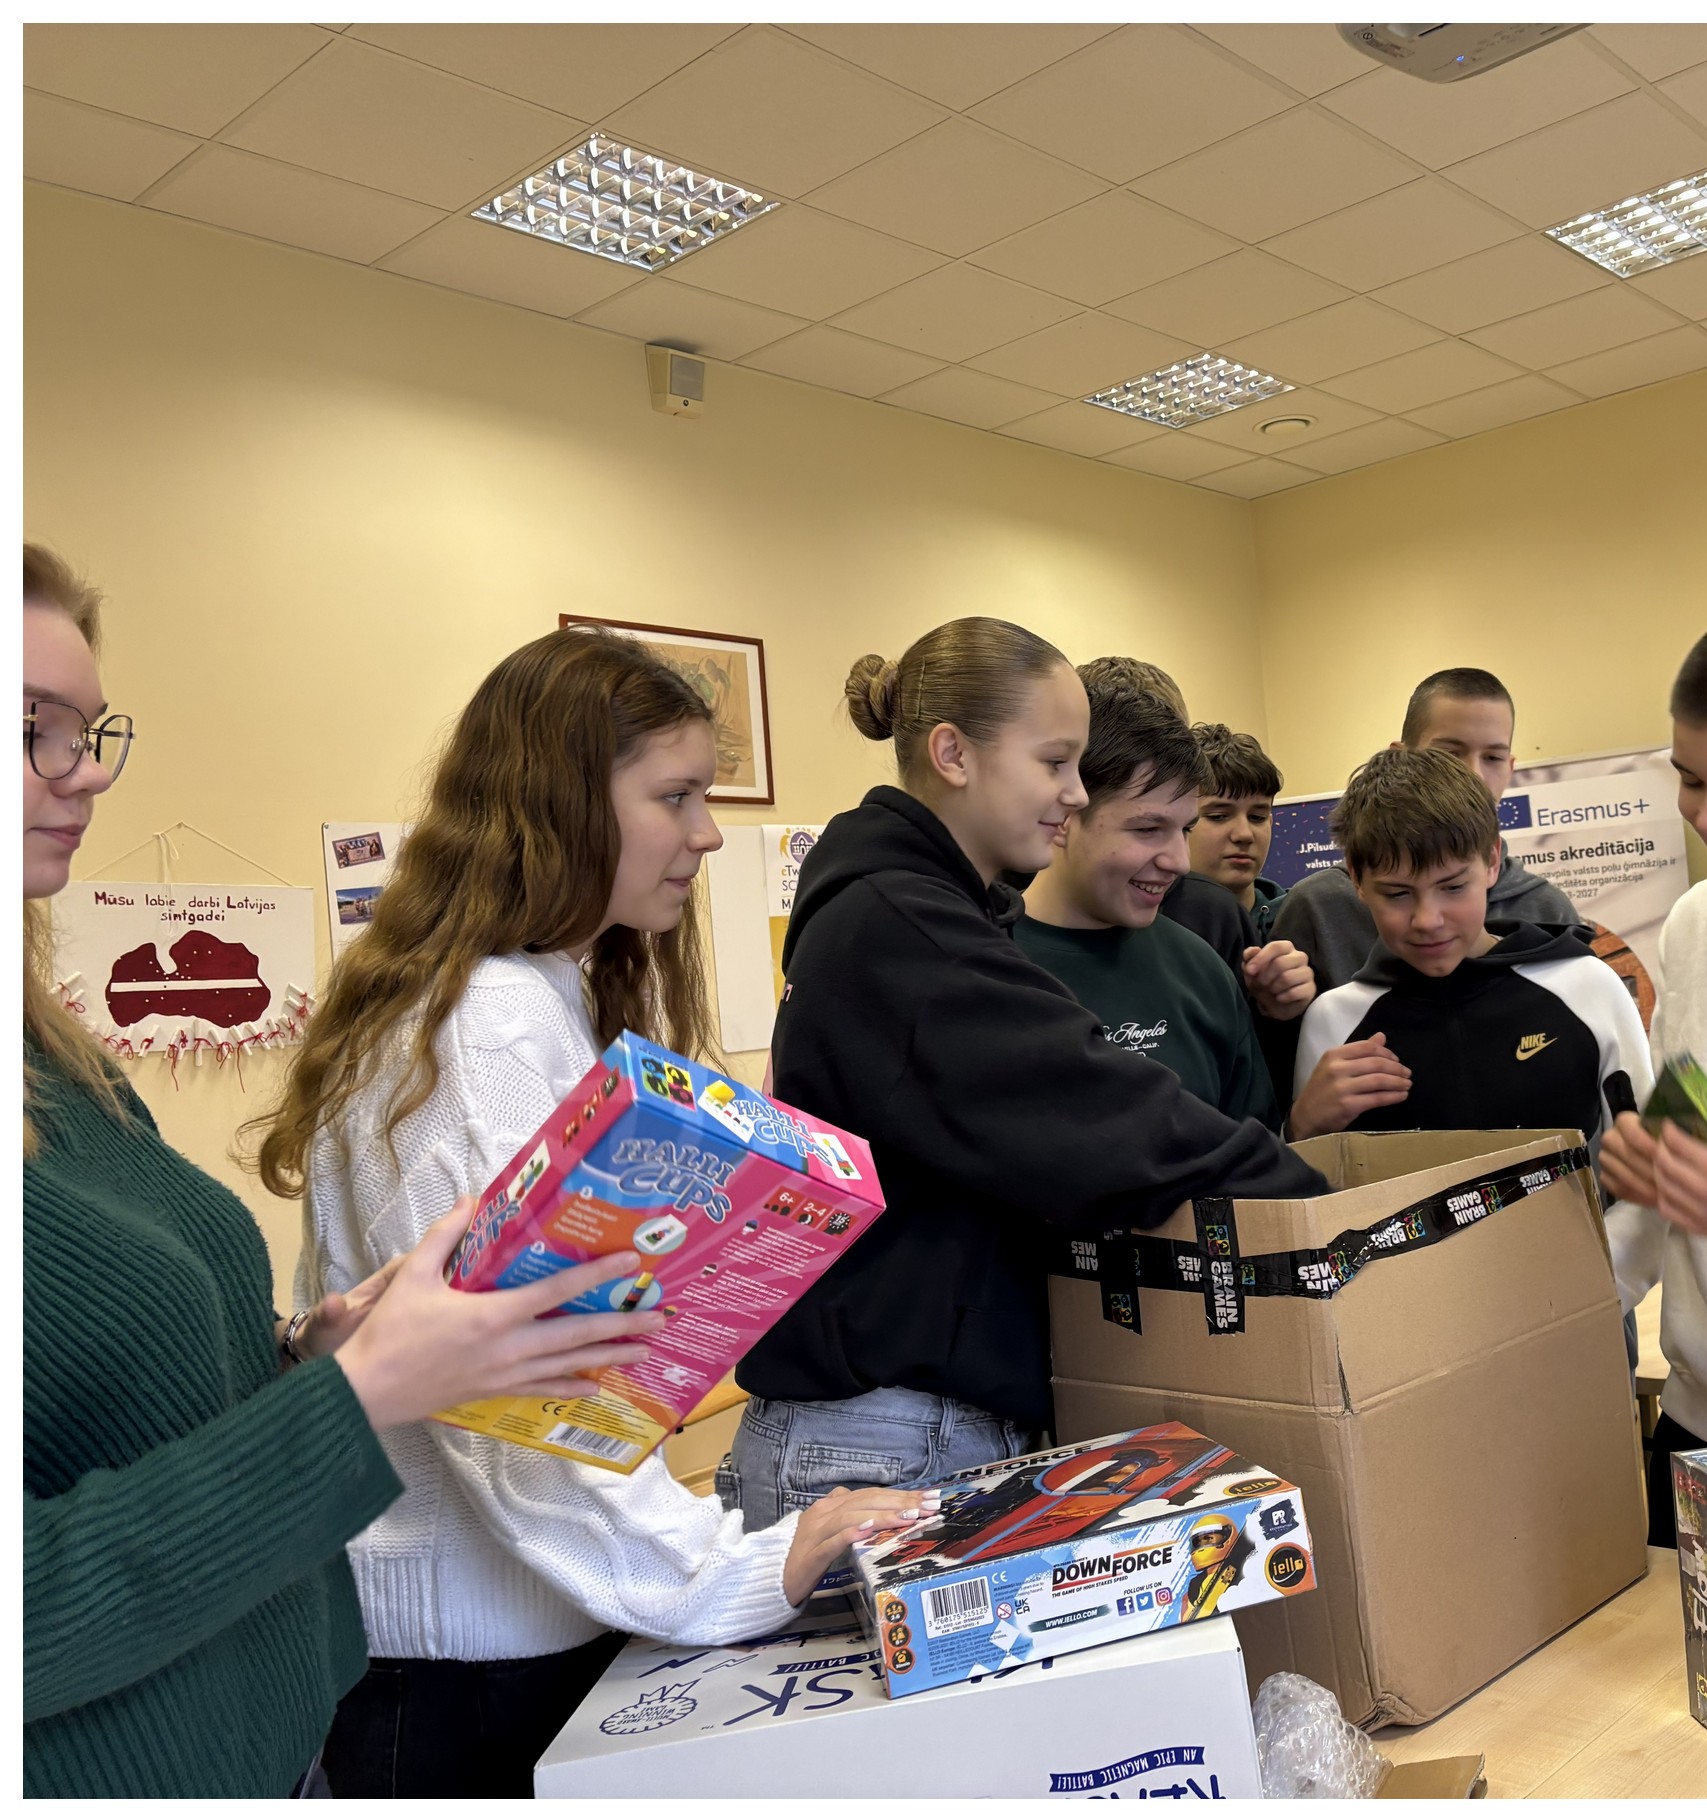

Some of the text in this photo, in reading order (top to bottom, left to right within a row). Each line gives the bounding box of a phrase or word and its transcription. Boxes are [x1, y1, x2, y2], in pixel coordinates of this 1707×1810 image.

[1537, 798, 1650, 827] Erasmus+
[1560, 838, 1655, 861] akreditācija
[1306, 859, 1331, 869] valsts
[1623, 859, 1668, 873] ģimnāzija
[1589, 873, 1644, 887] organizācija
[95, 891, 276, 915] Mūsu labie darbi Latvijas
[161, 910, 225, 925] simtgadei
[1520, 1032, 1547, 1050] NIKE
[734, 1097, 808, 1139] HALLI
[612, 1138, 736, 1186] HALLI
[614, 1163, 732, 1223] Cups
[1447, 1193, 1482, 1214] GAMES
[1455, 1204, 1486, 1225] BRAIN
[1210, 1261, 1228, 1329] GAMES
[1221, 1261, 1239, 1324] BRAIN
[1045, 1609, 1098, 1628] WWW.IELLO.COM
[1057, 1749, 1197, 1789] AN EPIC MAGNETIC BATTLE!
